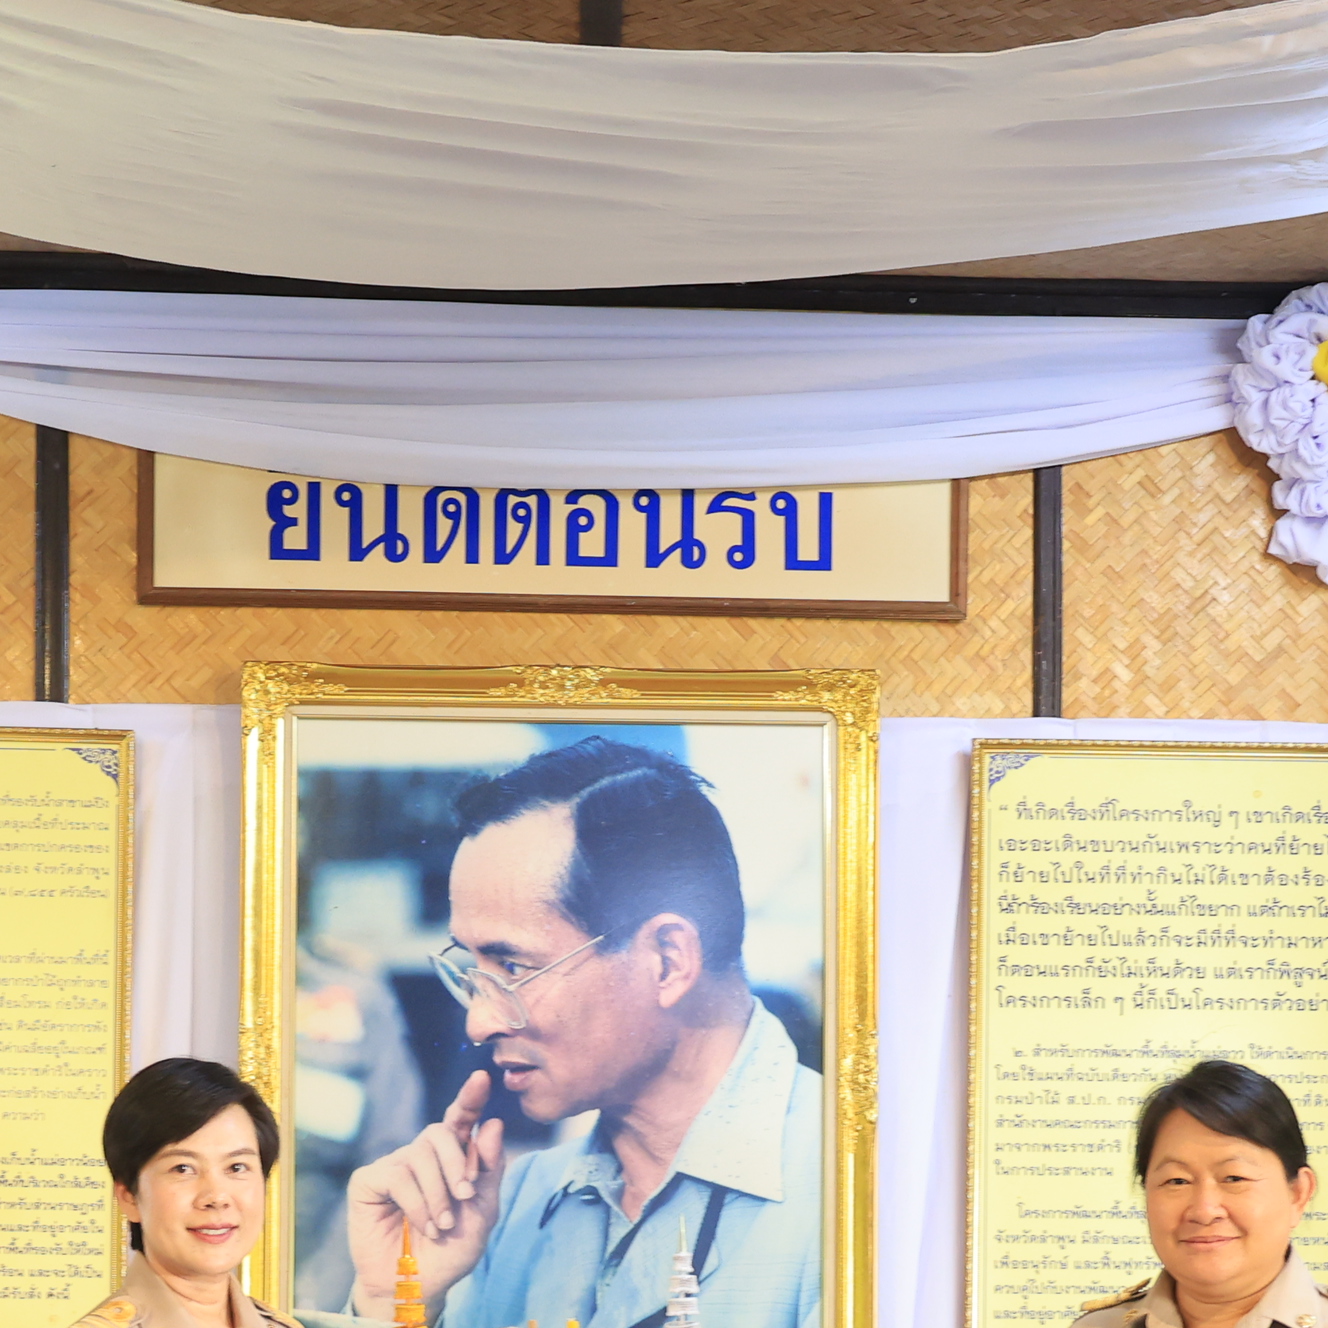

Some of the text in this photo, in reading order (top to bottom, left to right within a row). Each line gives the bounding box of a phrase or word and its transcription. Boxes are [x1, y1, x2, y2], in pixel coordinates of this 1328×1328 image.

[995, 984, 1107, 1010] โครงการเล็ก
